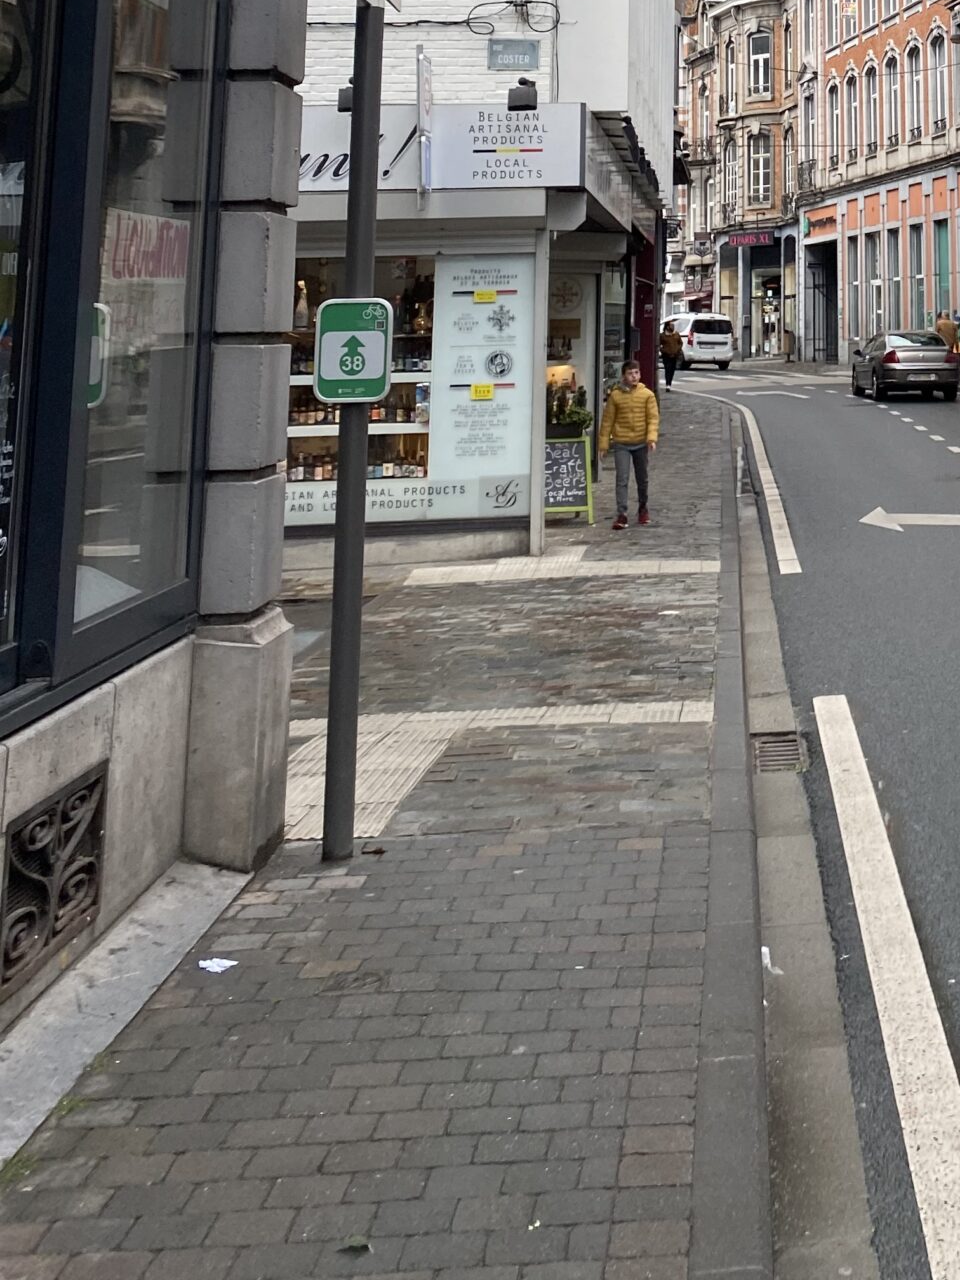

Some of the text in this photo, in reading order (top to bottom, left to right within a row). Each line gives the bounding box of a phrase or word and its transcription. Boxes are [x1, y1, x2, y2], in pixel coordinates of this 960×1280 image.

[497, 54, 530, 64] COSTER
[478, 111, 540, 122] BELGIAN
[468, 124, 549, 134] ARTISANAL
[473, 135, 543, 145] PRODUCTS
[486, 158, 529, 169] LOCAL
[472, 170, 543, 180] PRODUCTS
[341, 355, 363, 371] 38
[544, 459, 584, 474] Craft
[404, 484, 466, 496] PRODUCTS
[290, 500, 314, 512] AND
[371, 498, 434, 510] PRODUCTS
